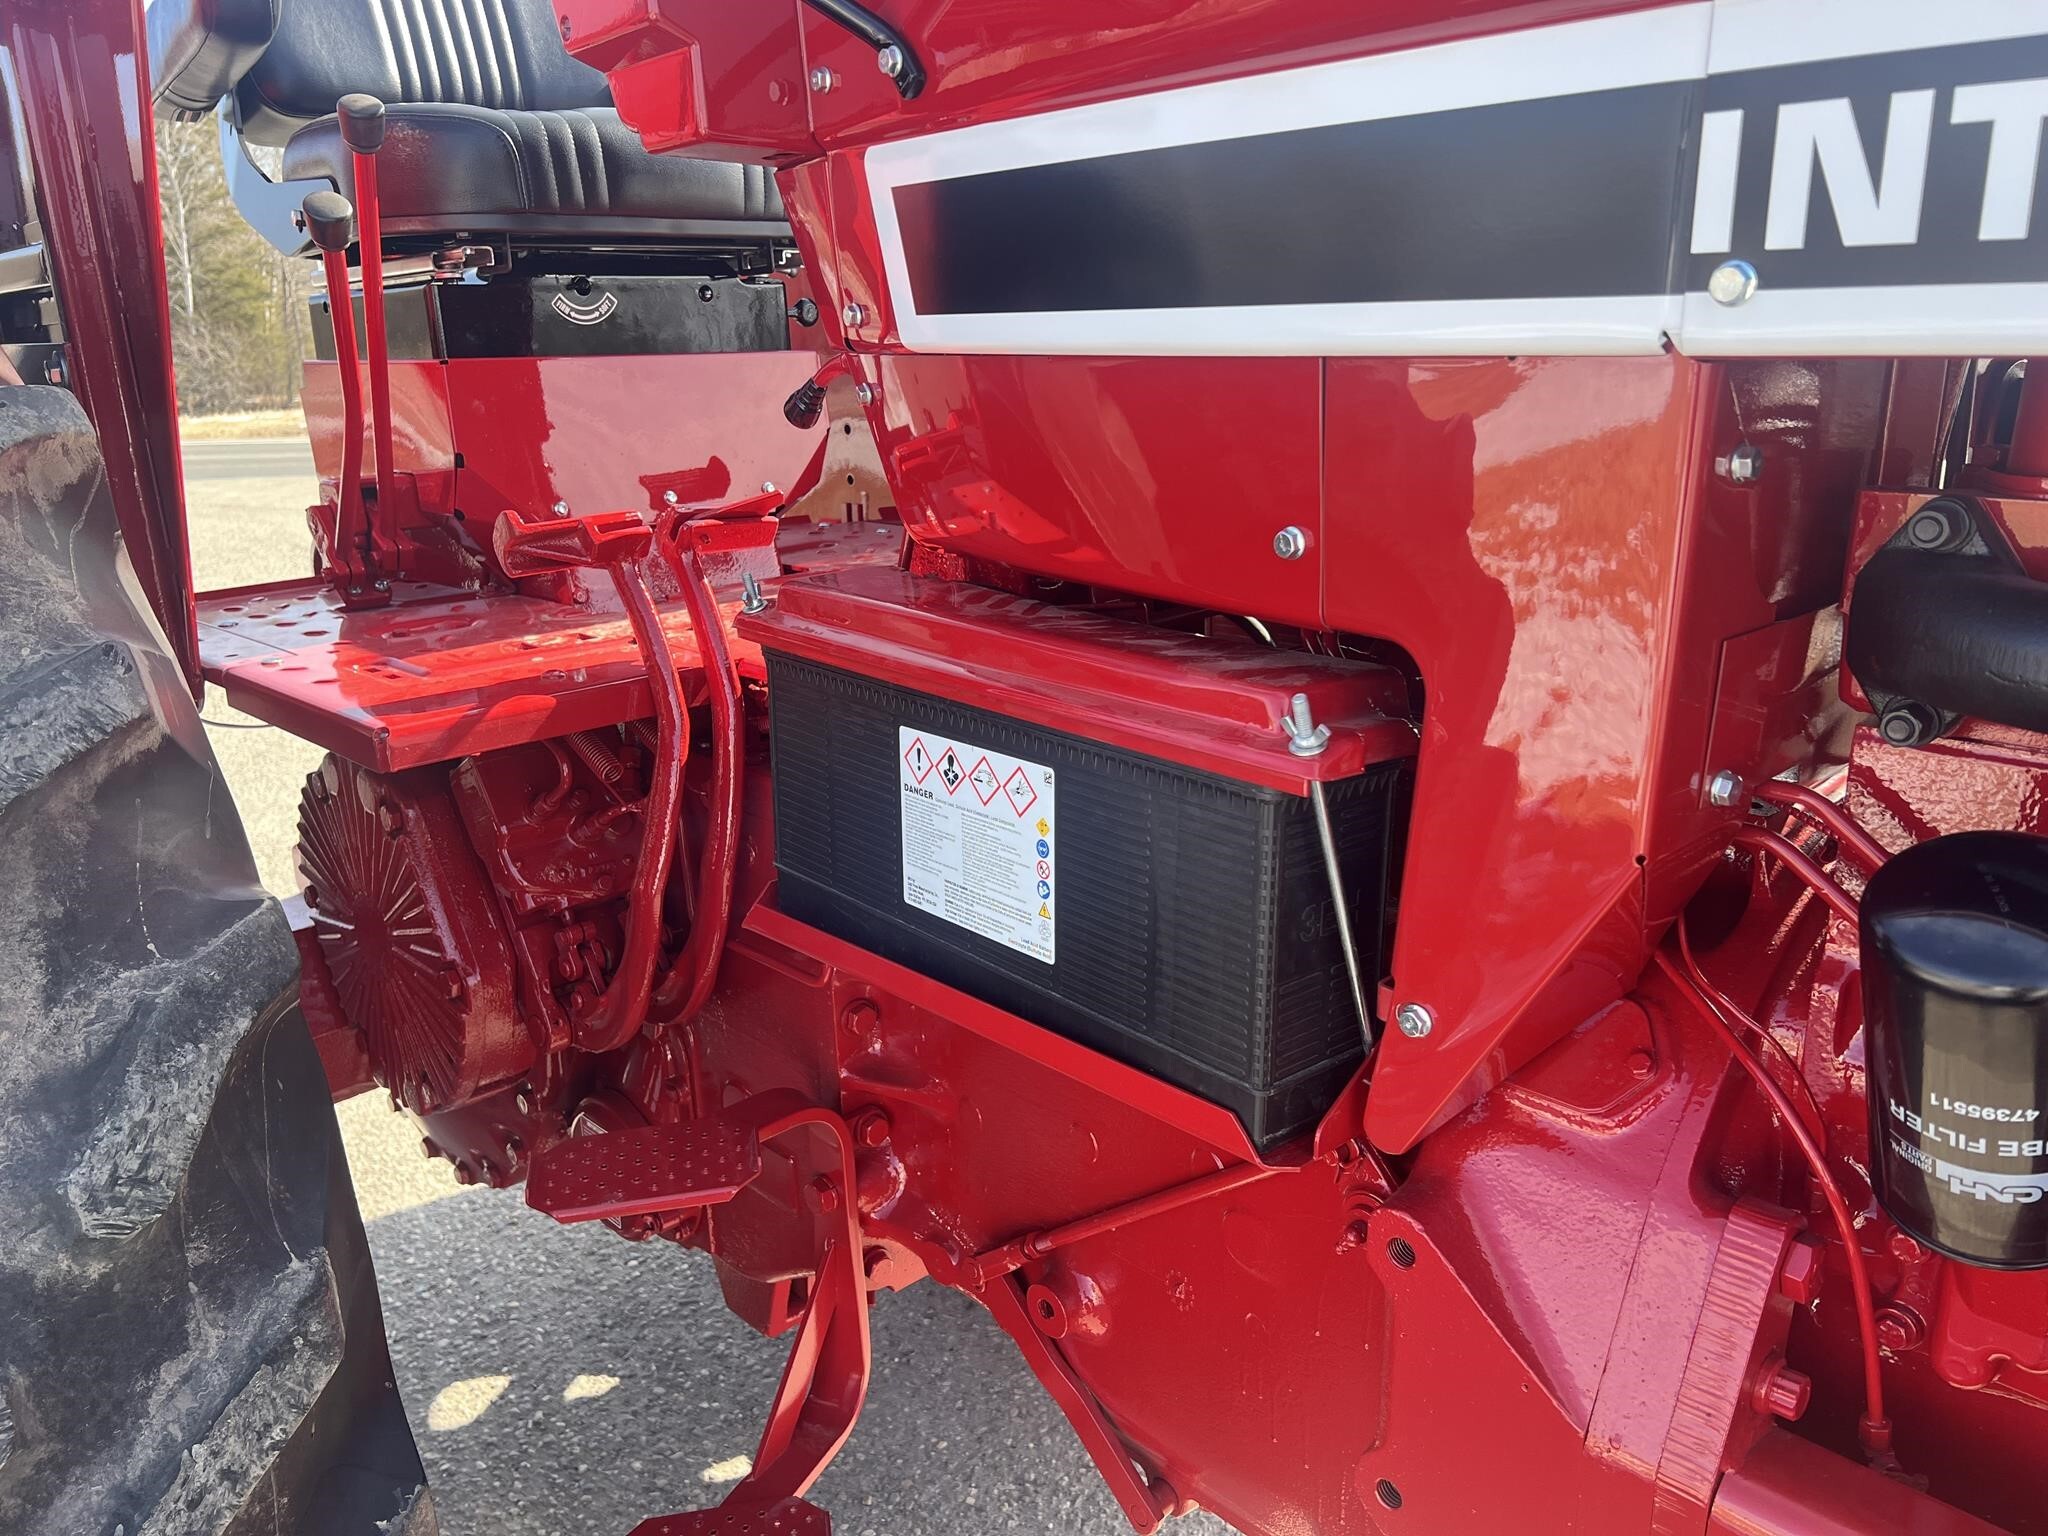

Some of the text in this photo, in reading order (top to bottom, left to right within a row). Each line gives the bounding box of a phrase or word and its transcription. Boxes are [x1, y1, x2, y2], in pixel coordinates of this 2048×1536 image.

[1690, 77, 2048, 254] INT
[556, 299, 612, 315] FIRM SOFT
[903, 782, 934, 800] DANGER
[1930, 1092, 2041, 1122] 47395511
[1890, 1098, 2048, 1157] BE FILTER
[1889, 1138, 1933, 1174] ORIGINAL
[1900, 1140, 1933, 1166] PARTS
[1950, 1175, 2043, 1204] CNH
